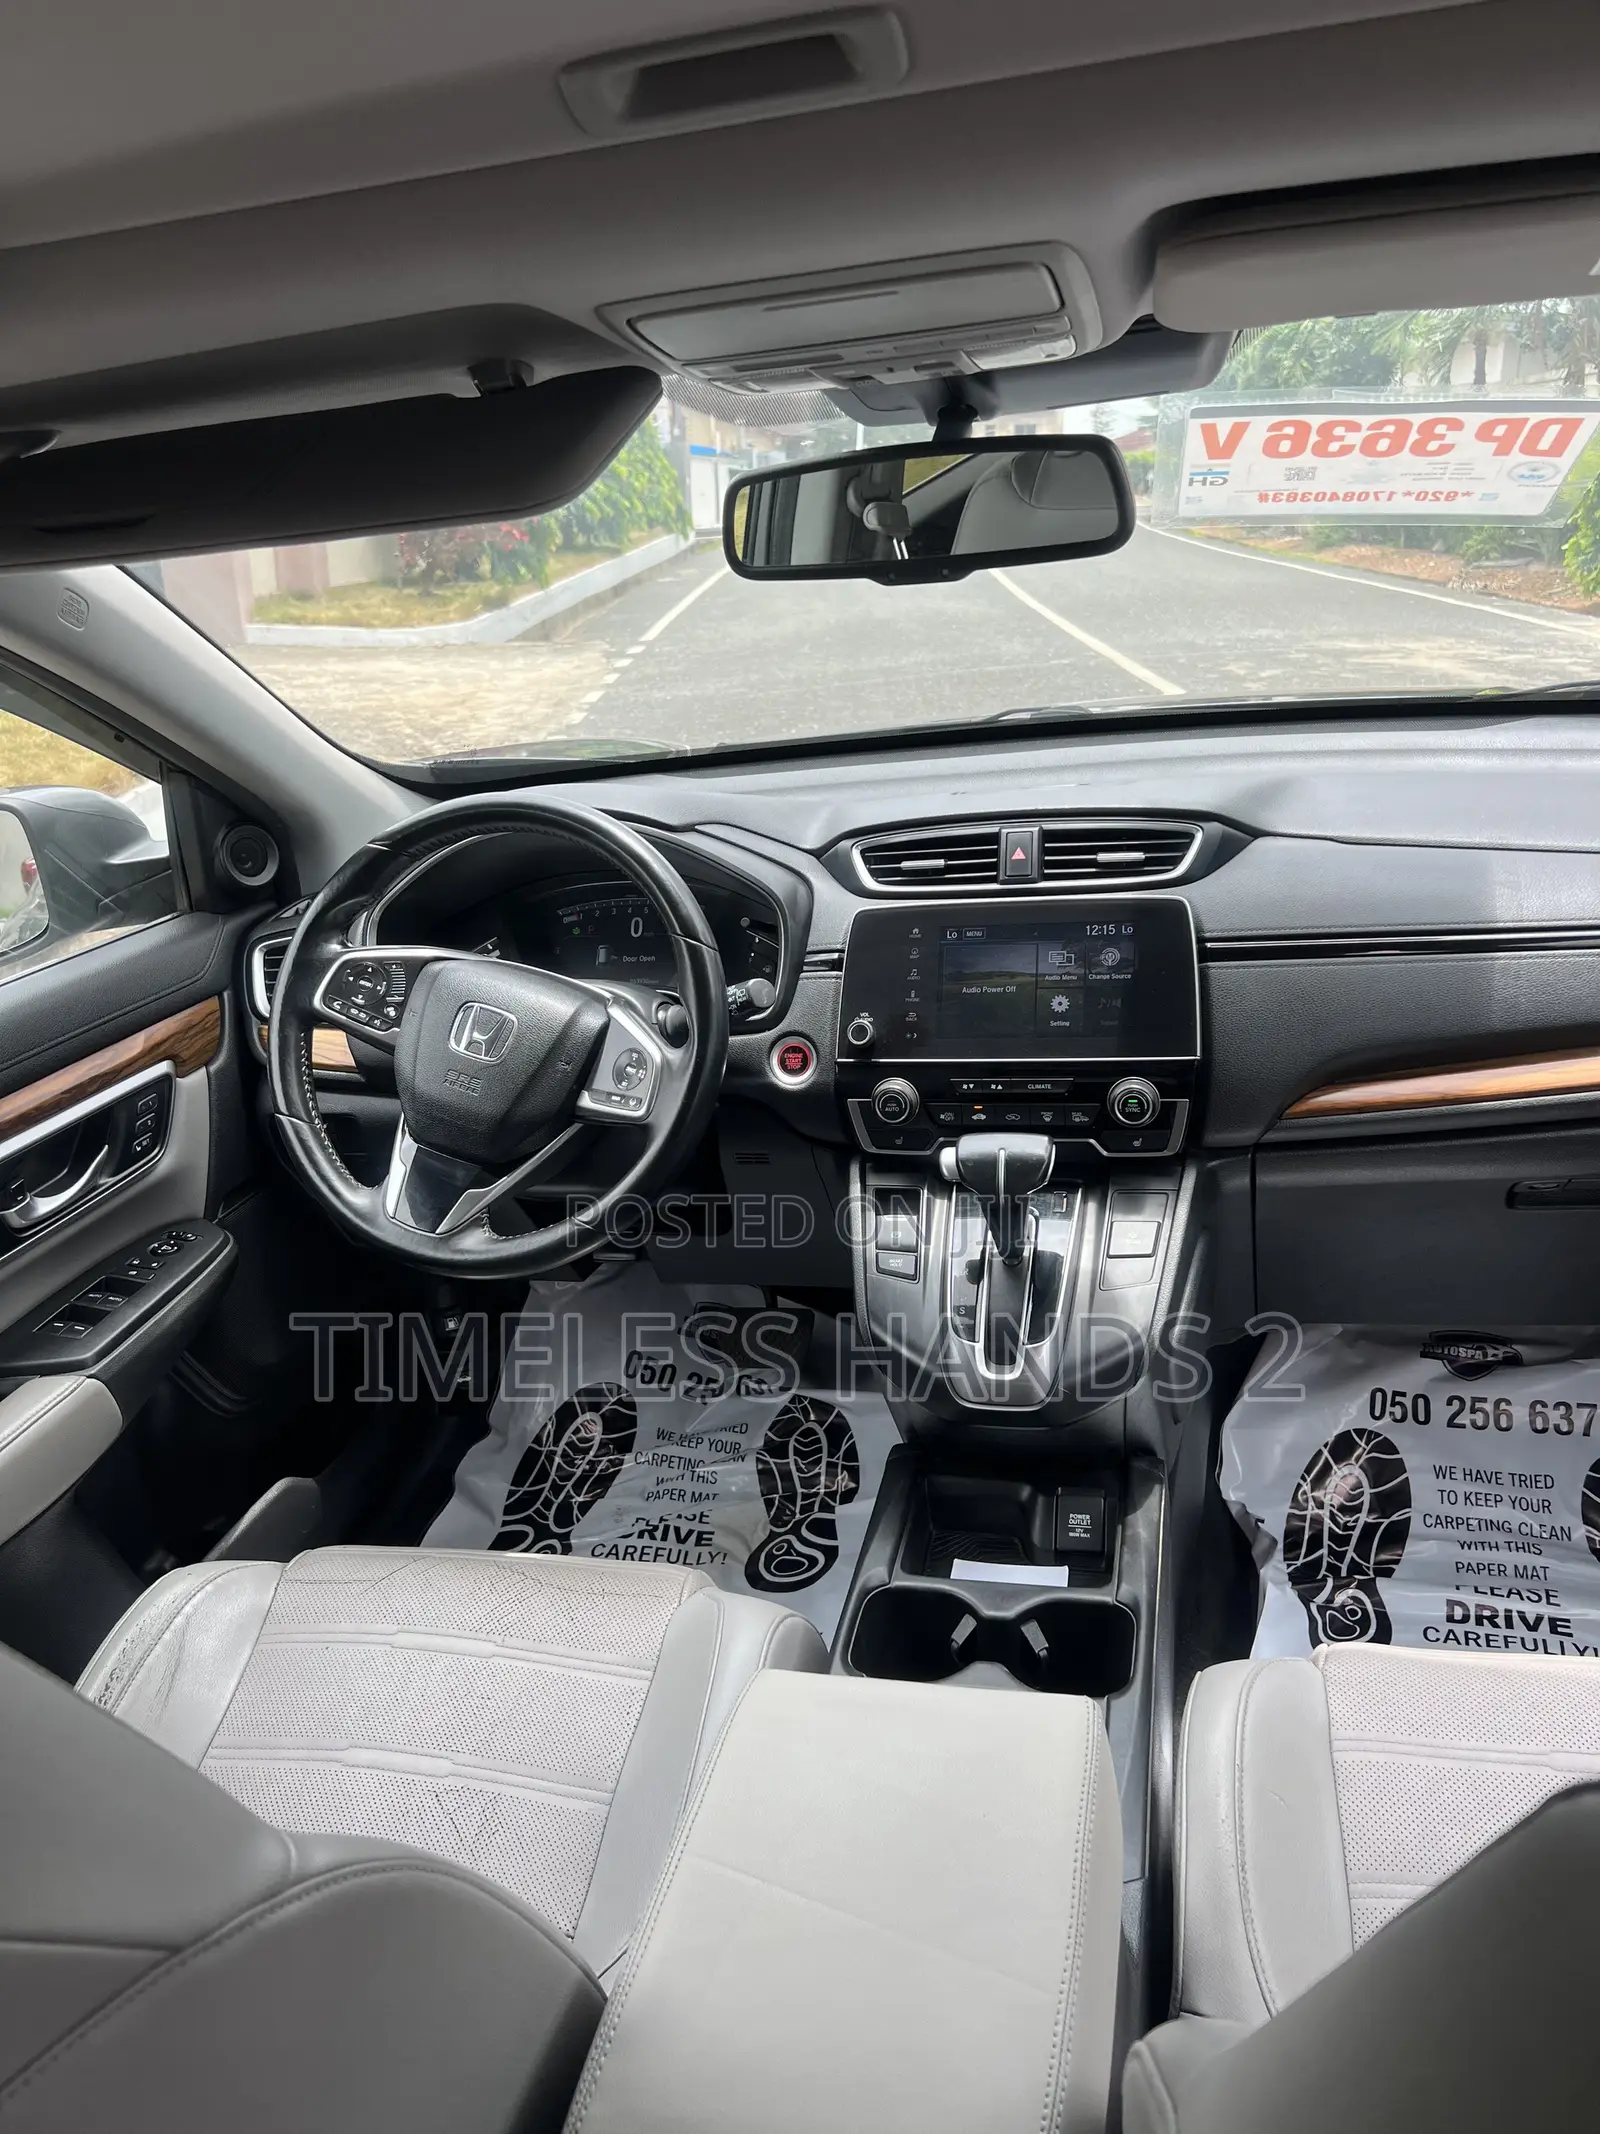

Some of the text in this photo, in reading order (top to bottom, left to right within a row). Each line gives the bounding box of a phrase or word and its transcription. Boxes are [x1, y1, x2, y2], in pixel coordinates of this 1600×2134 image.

[630, 916, 643, 938] 0
[947, 930, 958, 939] Lo
[1085, 924, 1134, 936] 12:15 Lo
[623, 954, 656, 963] Door Open
[962, 986, 981, 994] Audio
[1005, 985, 1017, 993] Off
[959, 1306, 966, 1315] S
[1368, 1386, 1599, 1437] 050 256 637
[656, 1426, 677, 1442] WE
[707, 1437, 742, 1454] YOUR
[689, 1469, 718, 1485] THIS
[1433, 1464, 1555, 1489] WE HAVE TRIED
[645, 1488, 719, 1504] PAPER MAT
[1437, 1489, 1553, 1515] TO KEEP YOUR
[1423, 1513, 1572, 1542] CARPETING CLEAN
[591, 1543, 728, 1566] CAREFULLY!
[1457, 1539, 1543, 1556] WITH THIS
[1455, 1561, 1550, 1582] PAPER MAT
[1445, 1598, 1575, 1639] DRIVE
